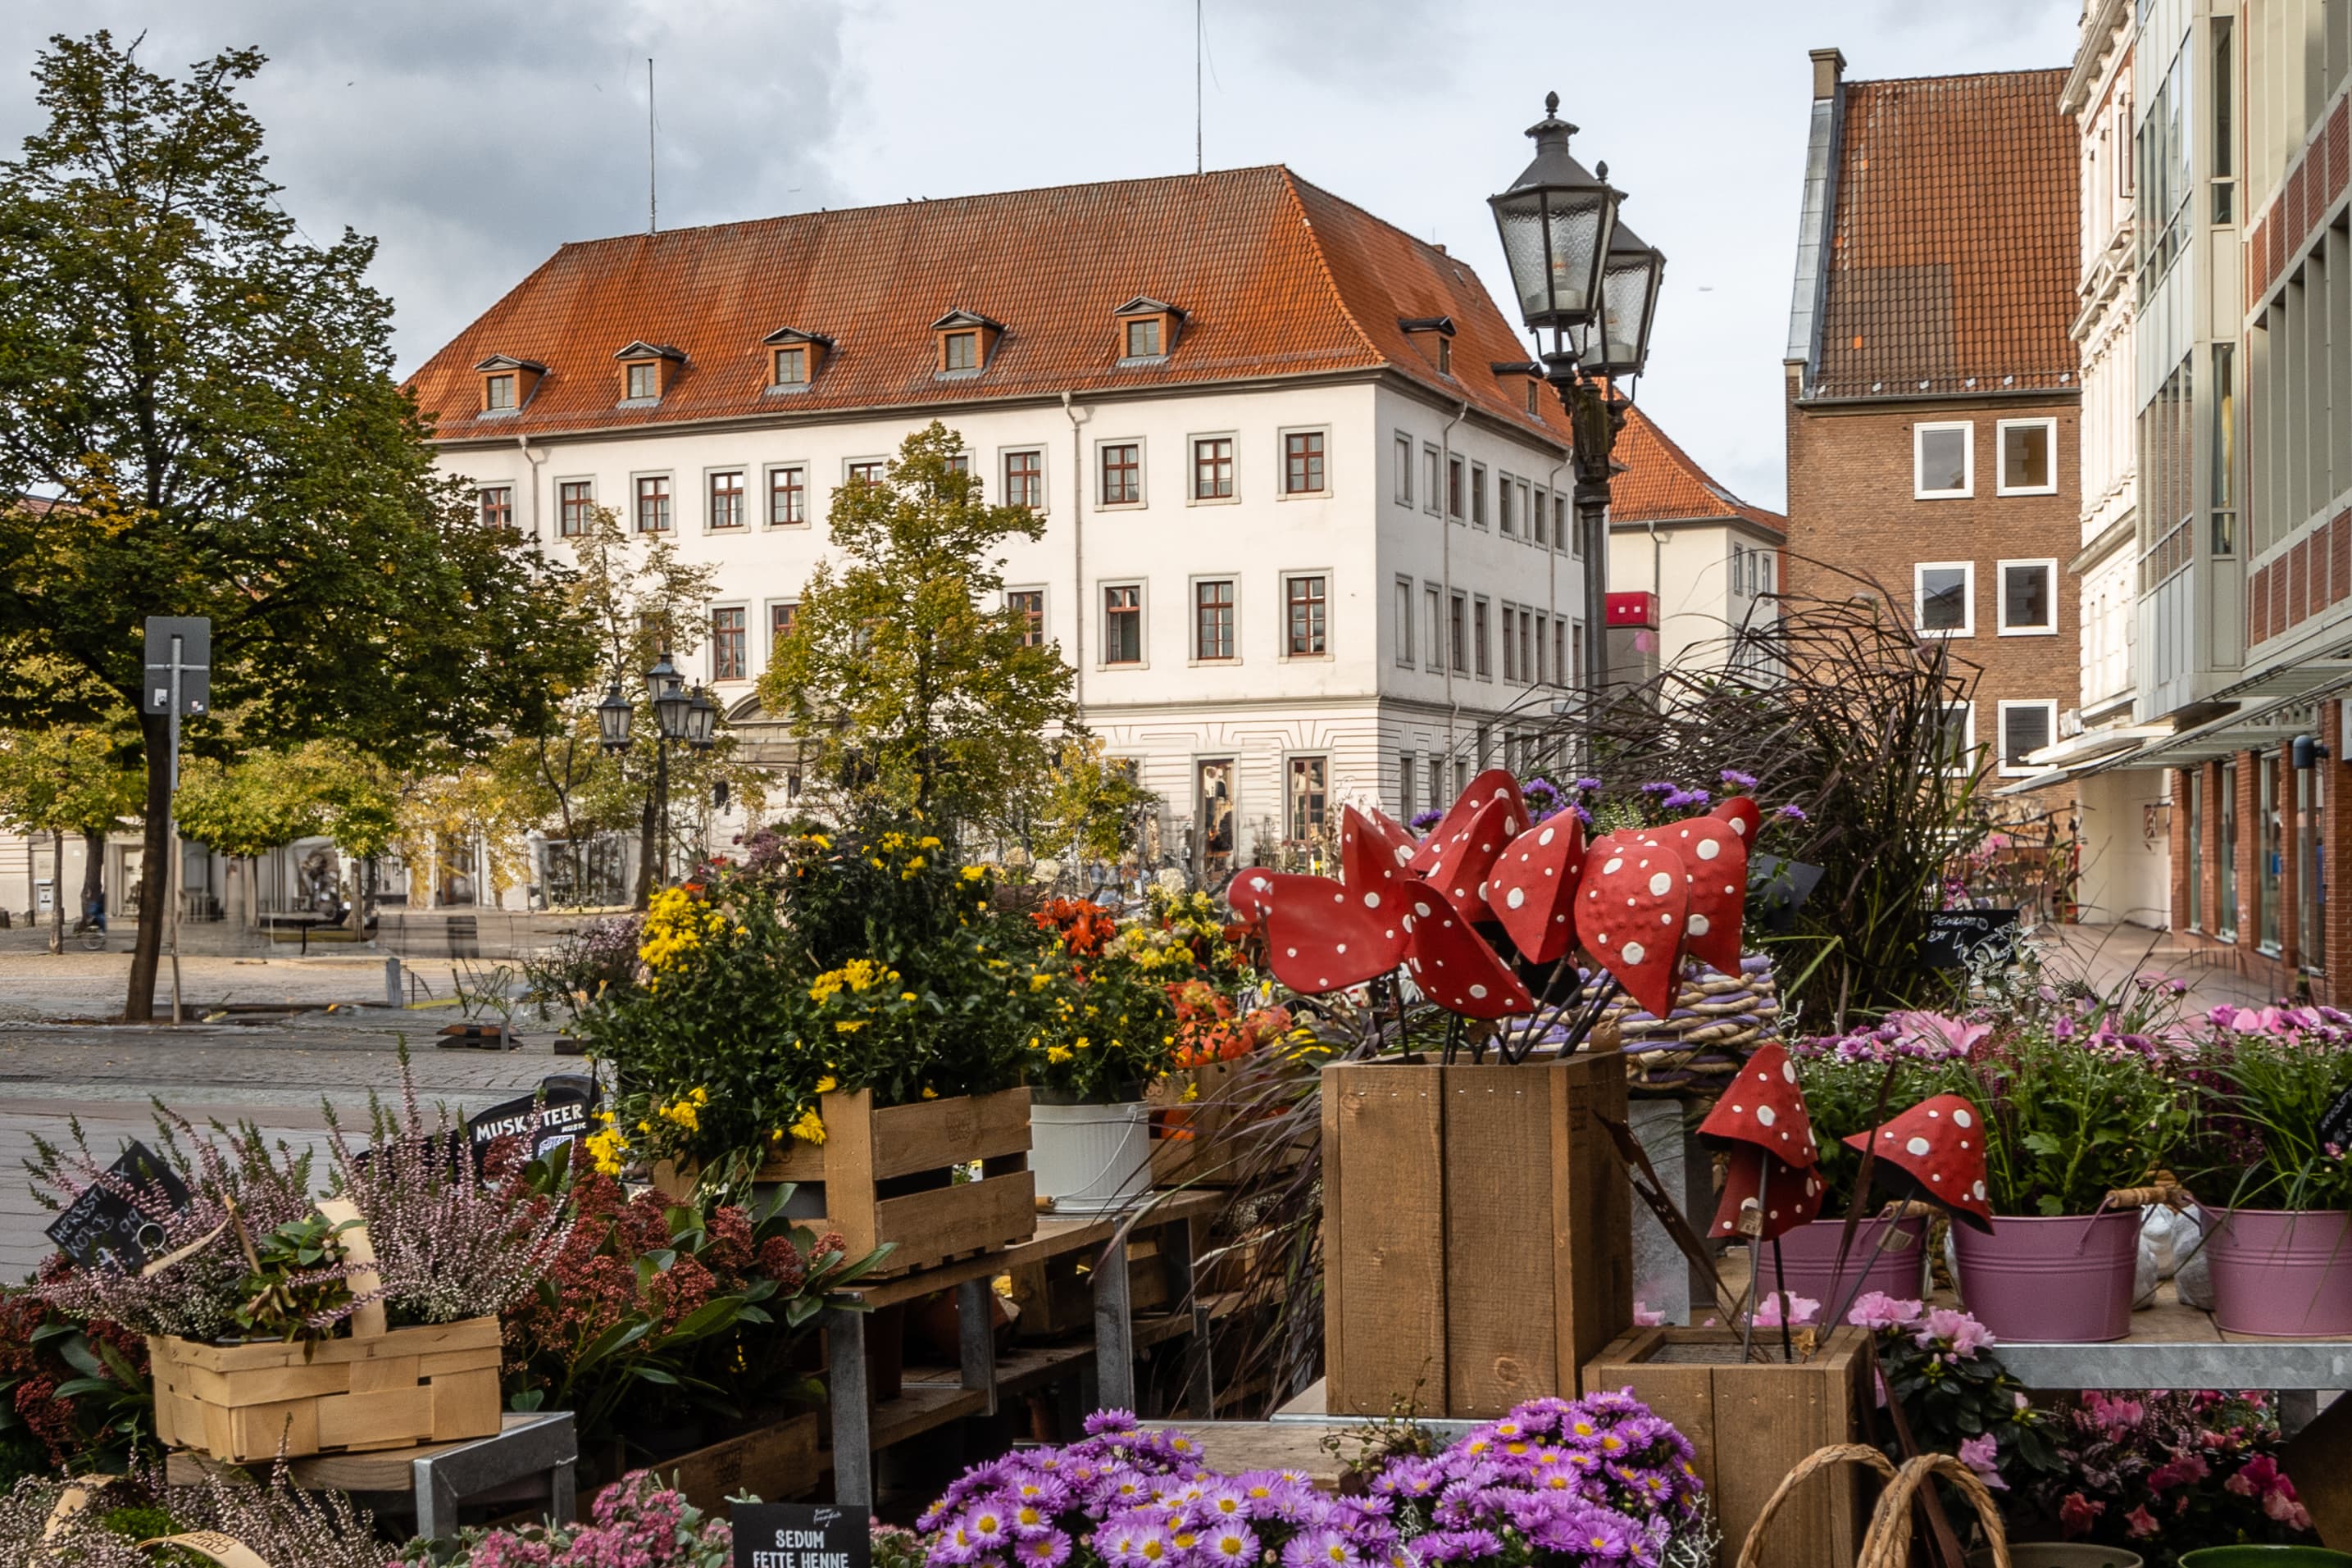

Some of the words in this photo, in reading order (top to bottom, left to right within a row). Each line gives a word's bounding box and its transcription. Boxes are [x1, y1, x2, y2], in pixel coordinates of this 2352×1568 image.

[561, 1122, 586, 1134] MUSIC
[66, 1213, 115, 1258] KORB
[776, 1529, 825, 1549] SEDUM
[753, 1551, 796, 1568] FETTE
[801, 1552, 849, 1568] HENNE
